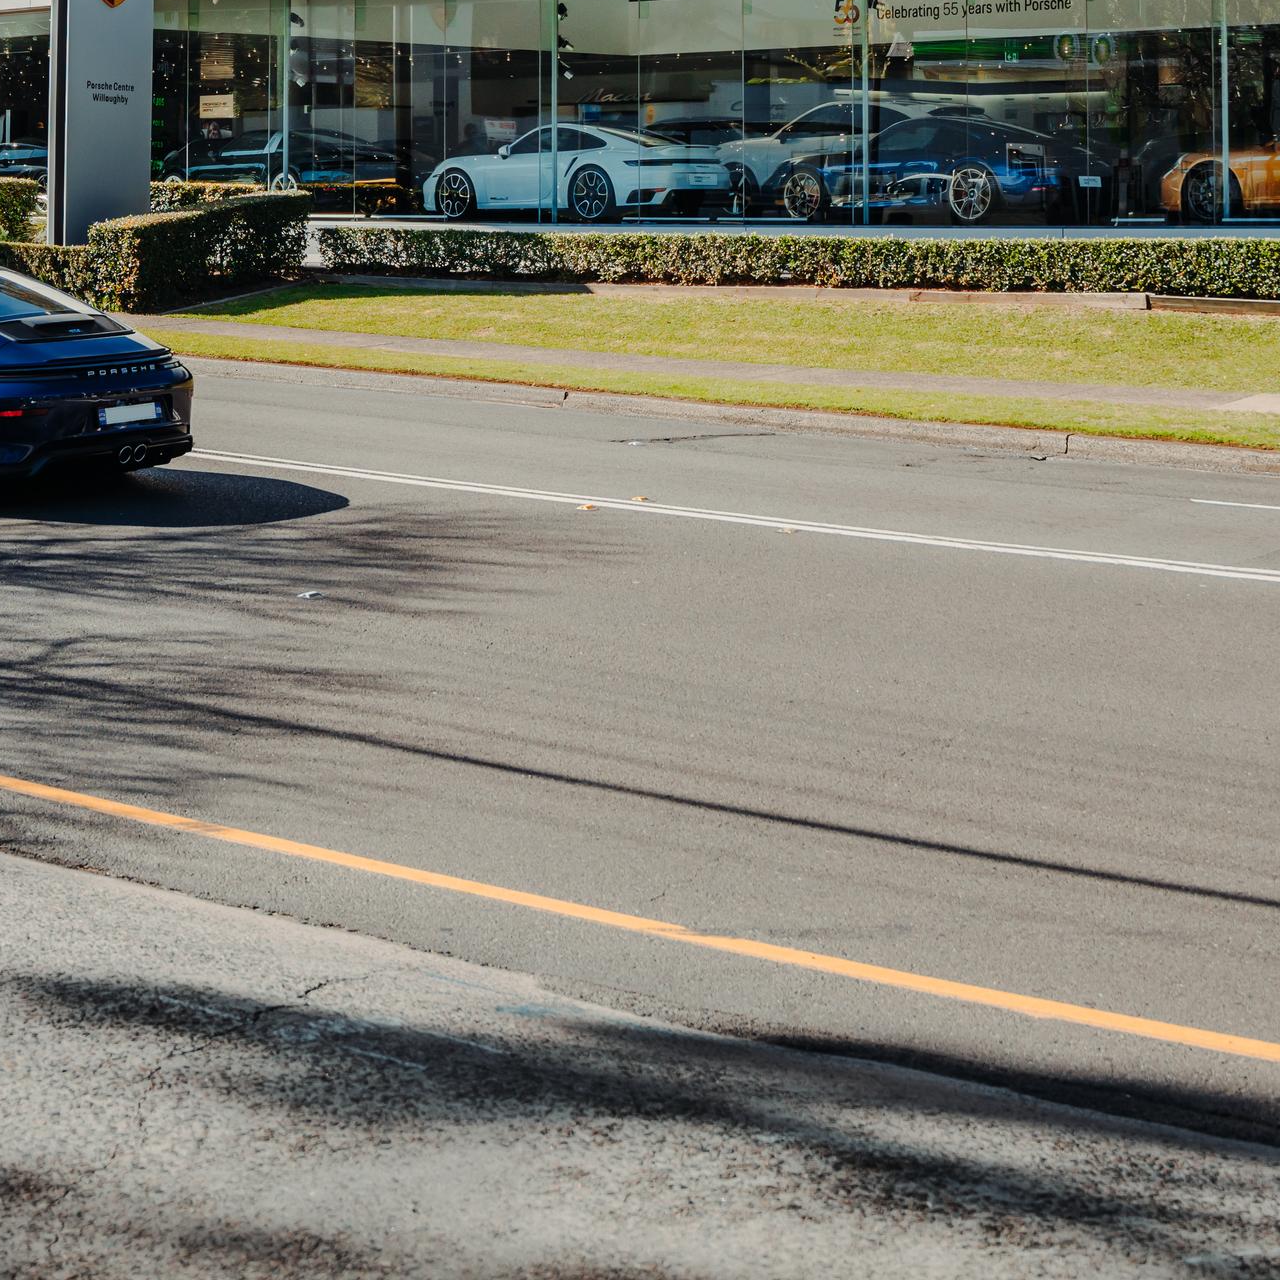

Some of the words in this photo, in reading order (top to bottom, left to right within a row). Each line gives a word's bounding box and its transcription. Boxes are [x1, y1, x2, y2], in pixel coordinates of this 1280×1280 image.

[877, 4, 940, 20] Celebrating
[943, 2, 959, 16] 55
[962, 2, 992, 18] years
[87, 80, 112, 90] Porsche
[113, 82, 134, 91] Centre
[93, 93, 128, 105] Willoughby
[87, 364, 155, 376] PORSCHE
